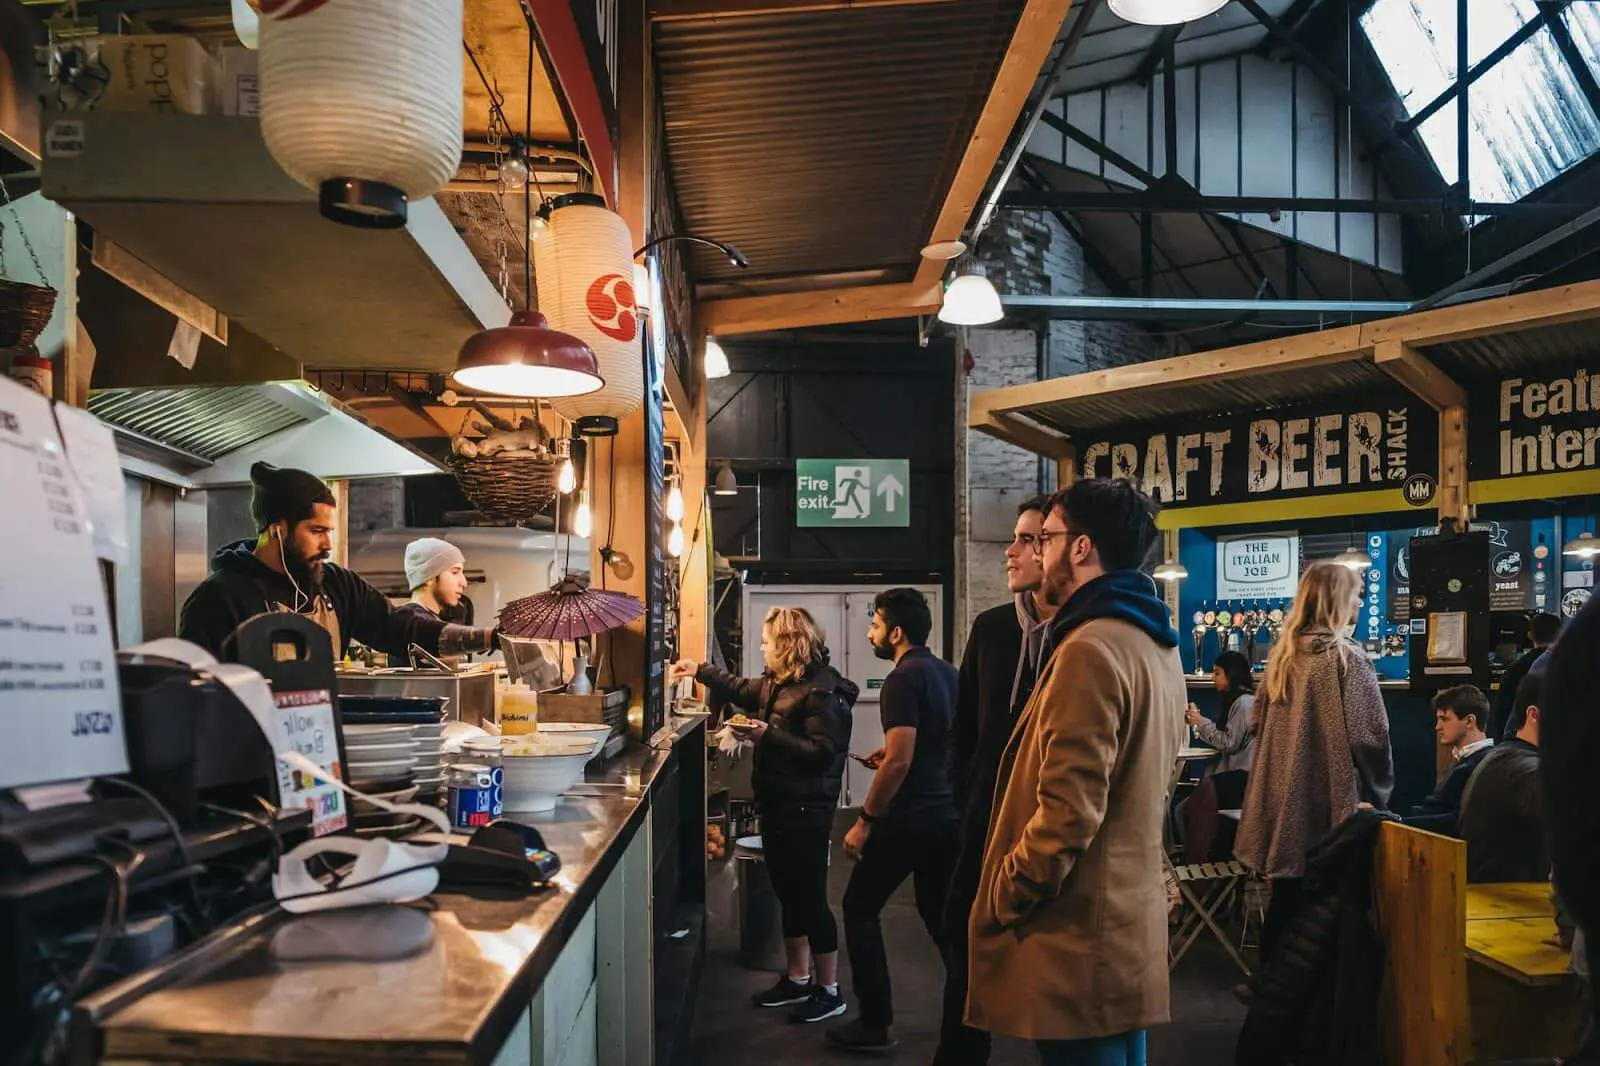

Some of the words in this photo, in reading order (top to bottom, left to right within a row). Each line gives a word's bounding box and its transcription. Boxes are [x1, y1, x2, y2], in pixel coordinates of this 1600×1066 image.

[1083, 429, 1232, 503] CRAFT
[1248, 411, 1384, 494] BEER
[1386, 407, 1408, 481] SHACK
[798, 476, 829, 491] Fire
[798, 494, 829, 509] exit
[1245, 542, 1269, 553] THE
[1232, 553, 1281, 566] ITALIAN
[1244, 566, 1268, 577] JOB
